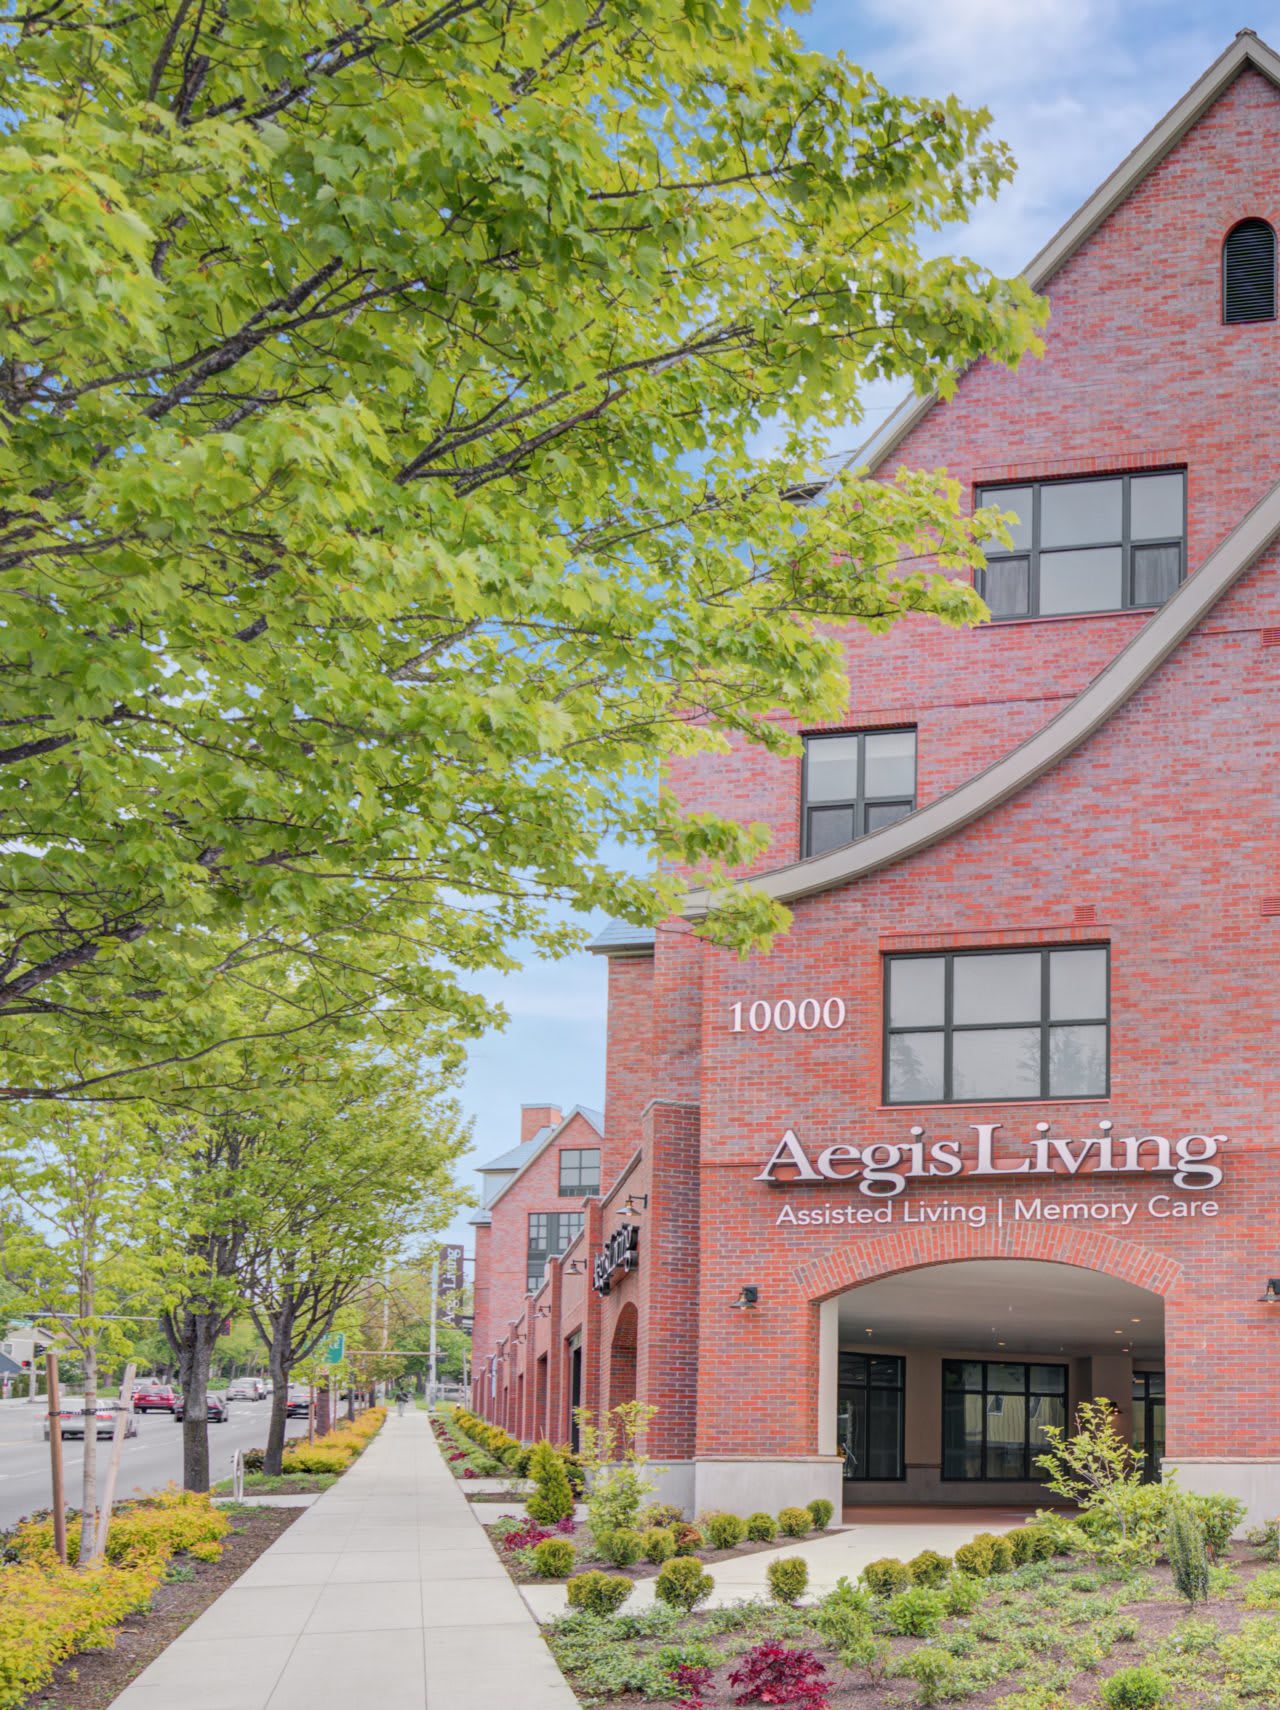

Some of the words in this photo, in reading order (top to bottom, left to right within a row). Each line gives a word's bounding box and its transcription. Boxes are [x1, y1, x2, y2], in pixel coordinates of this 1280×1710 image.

[729, 997, 845, 1032] 10000
[775, 1200, 893, 1226] Assisted
[903, 1200, 987, 1228] Living
[1014, 1198, 1138, 1225] Memory
[1148, 1195, 1219, 1218] Care
